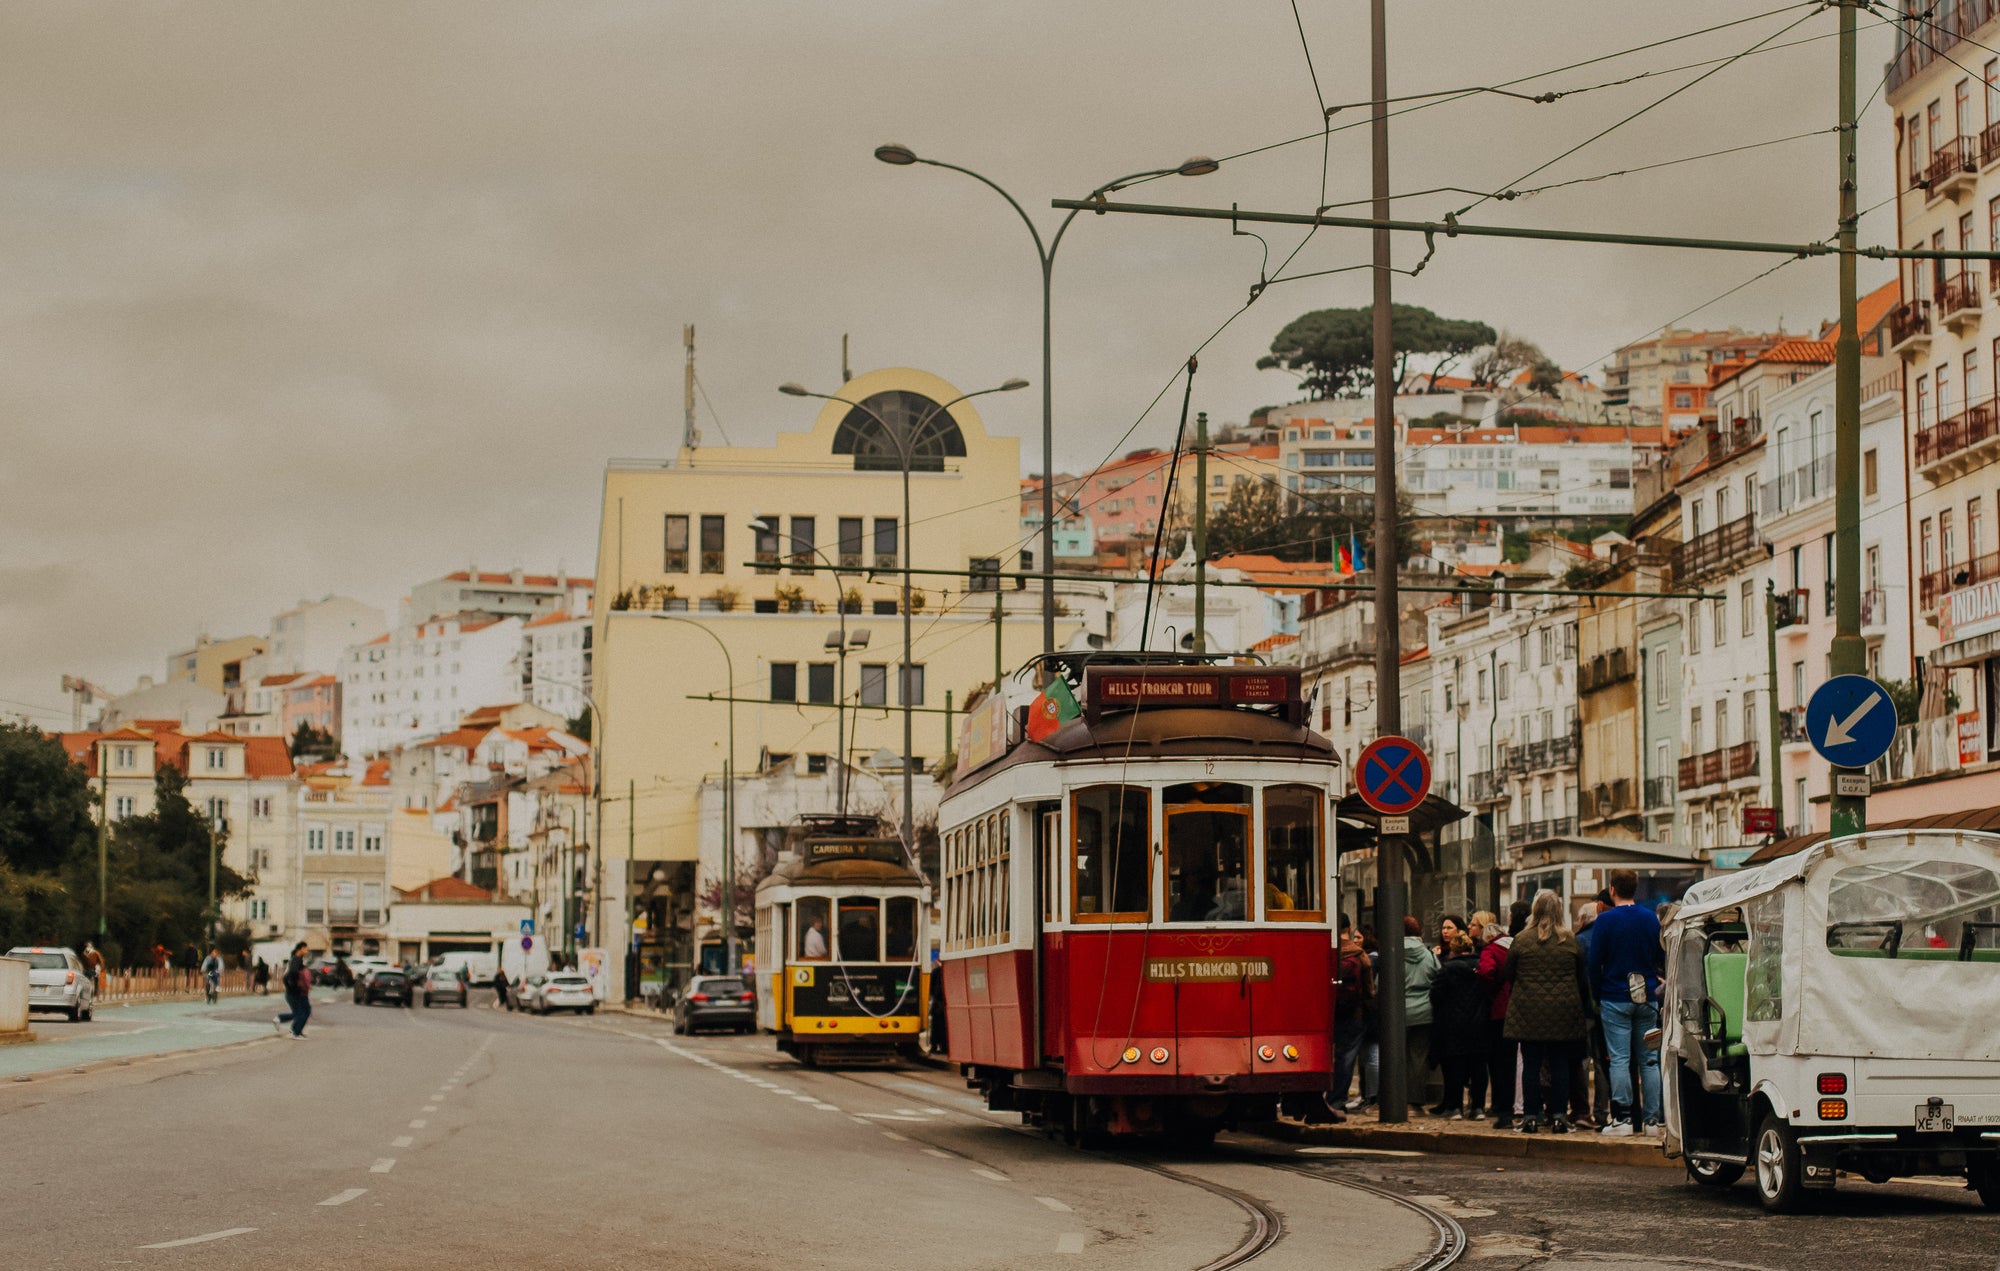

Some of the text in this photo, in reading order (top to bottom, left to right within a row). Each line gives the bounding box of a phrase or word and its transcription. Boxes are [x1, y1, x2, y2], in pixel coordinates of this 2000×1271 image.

[1108, 682, 1212, 695] HILLS TRAMCAR TOUR
[1204, 762, 1215, 775] 12
[813, 844, 854, 855] CARREIRA
[1150, 961, 1269, 978] HILLS TRAMCAR TOUR
[1928, 1106, 1942, 1118] 63
